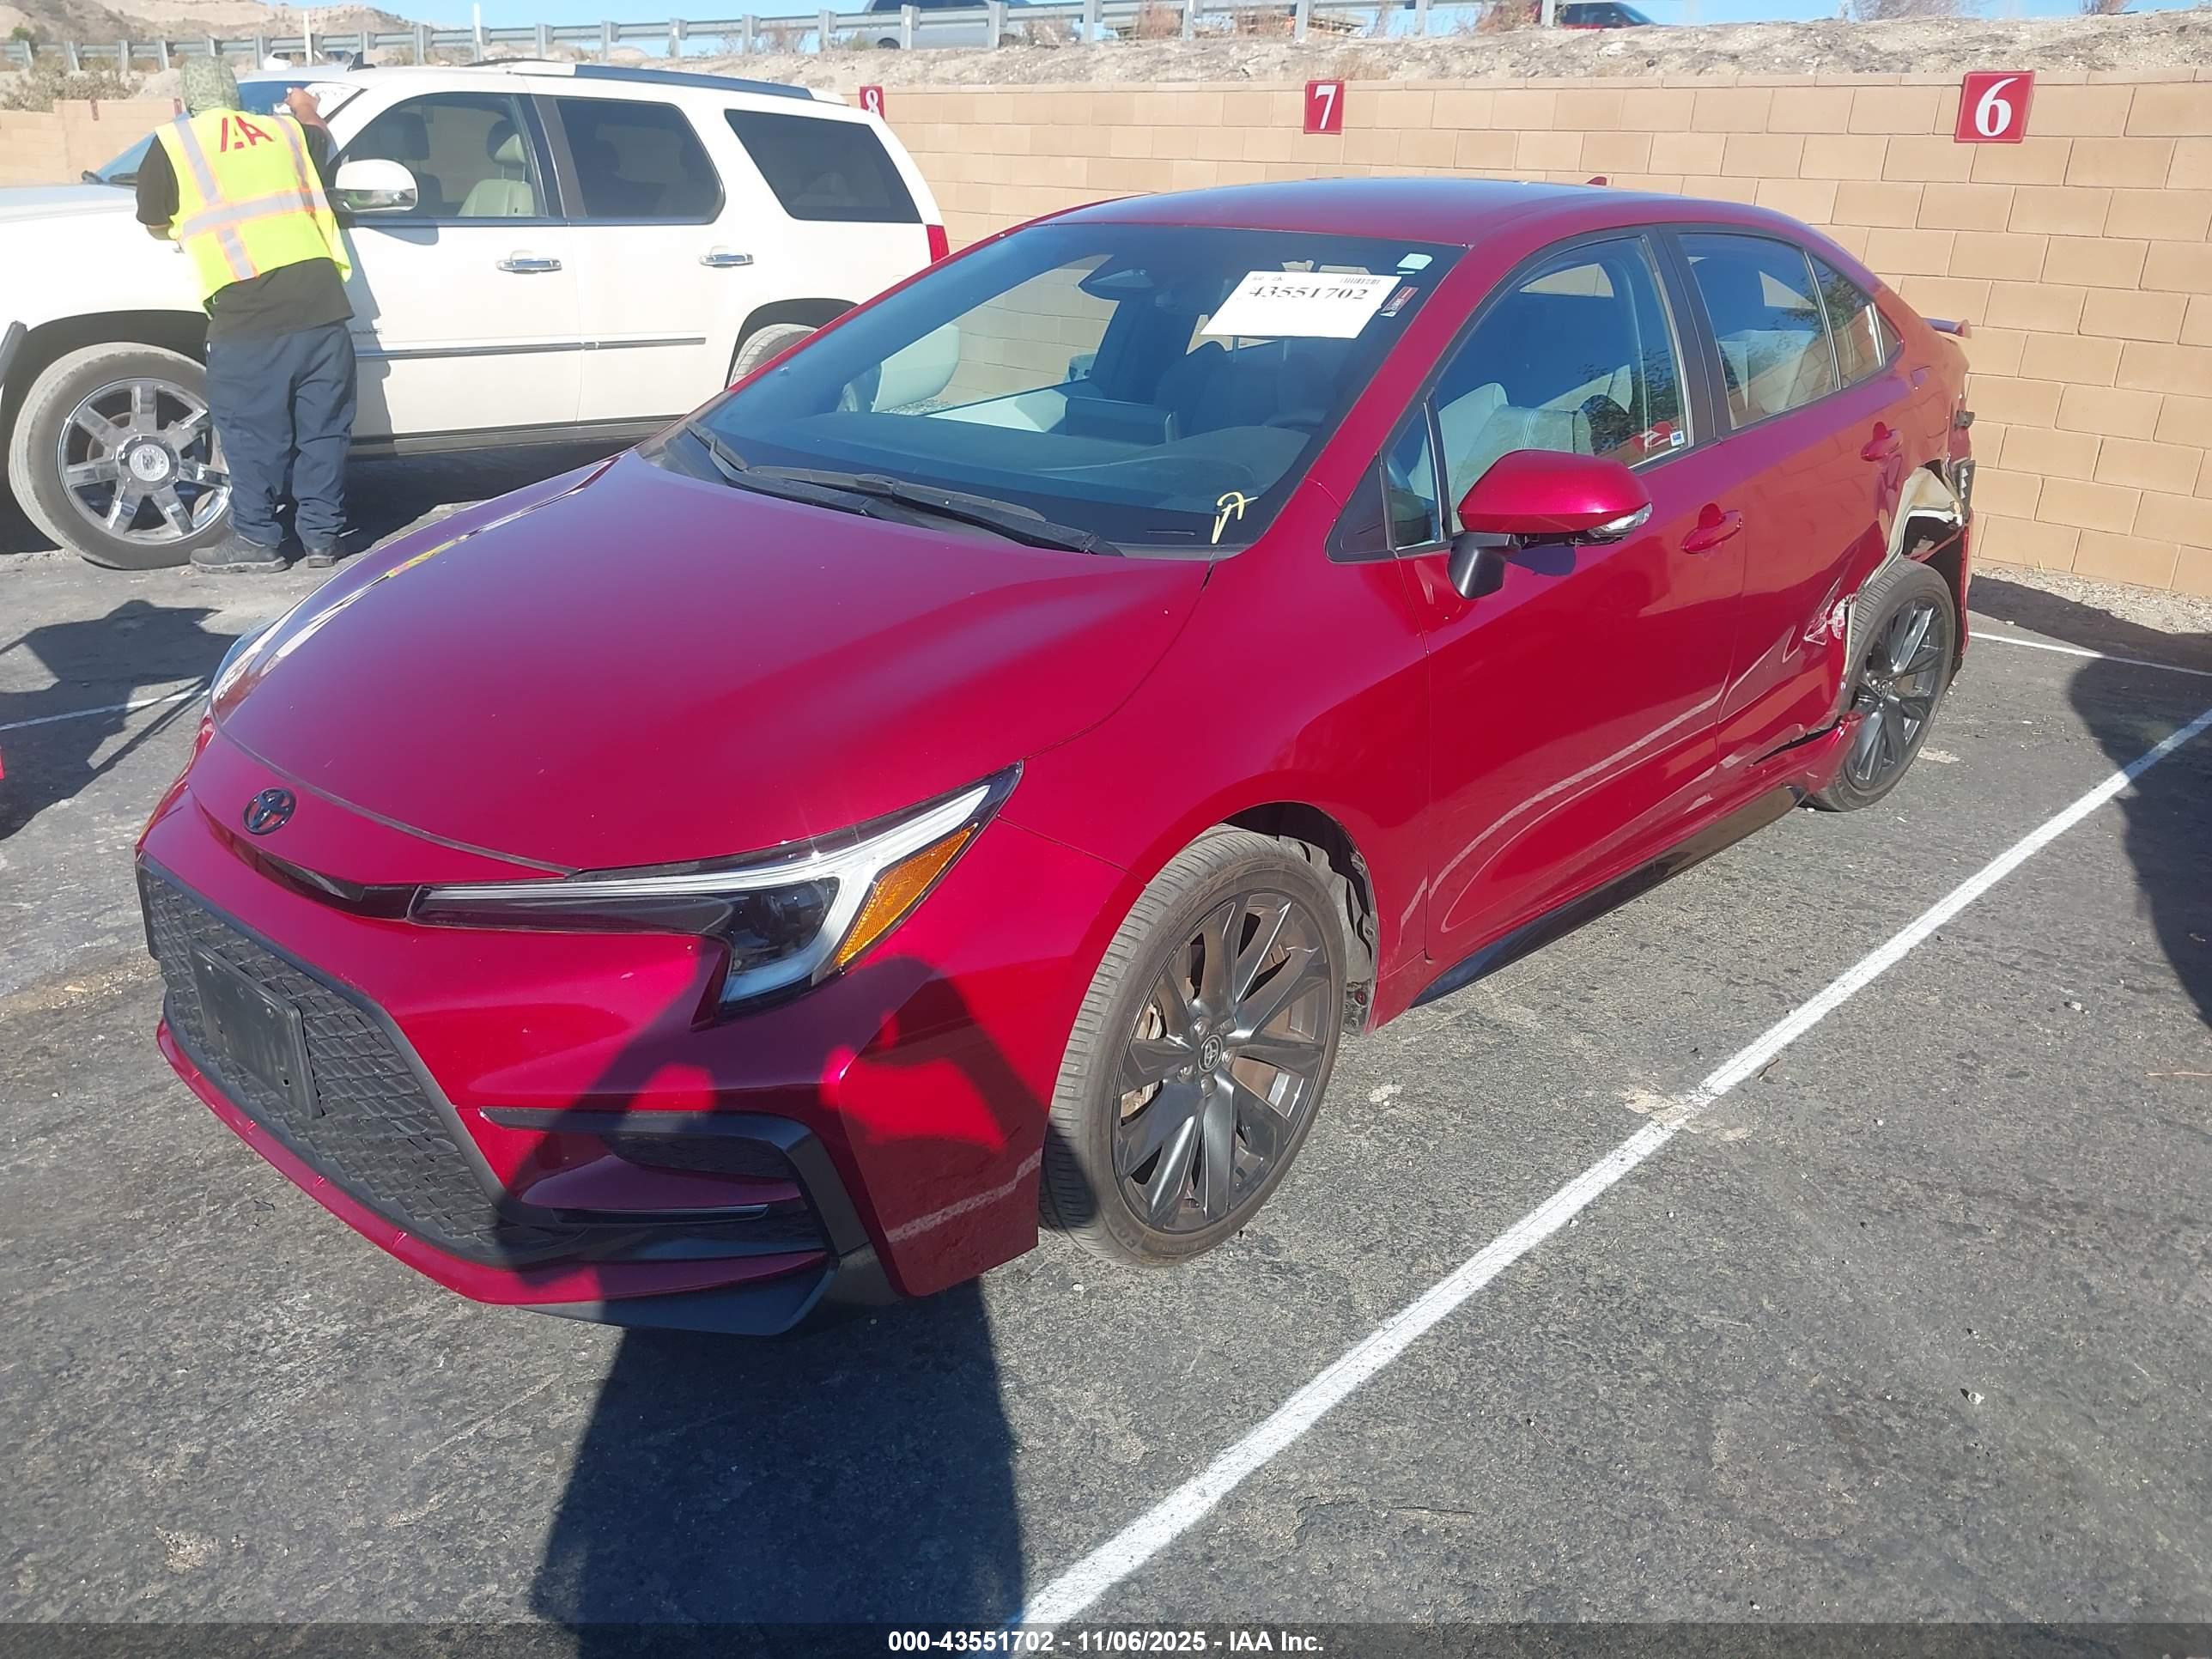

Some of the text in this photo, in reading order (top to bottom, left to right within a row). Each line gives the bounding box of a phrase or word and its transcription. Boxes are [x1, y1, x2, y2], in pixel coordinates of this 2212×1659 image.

[865, 89, 880, 114] 8
[1315, 84, 1337, 130] 7
[1975, 77, 2019, 137] 6
[1249, 285, 1369, 301] 43551702
